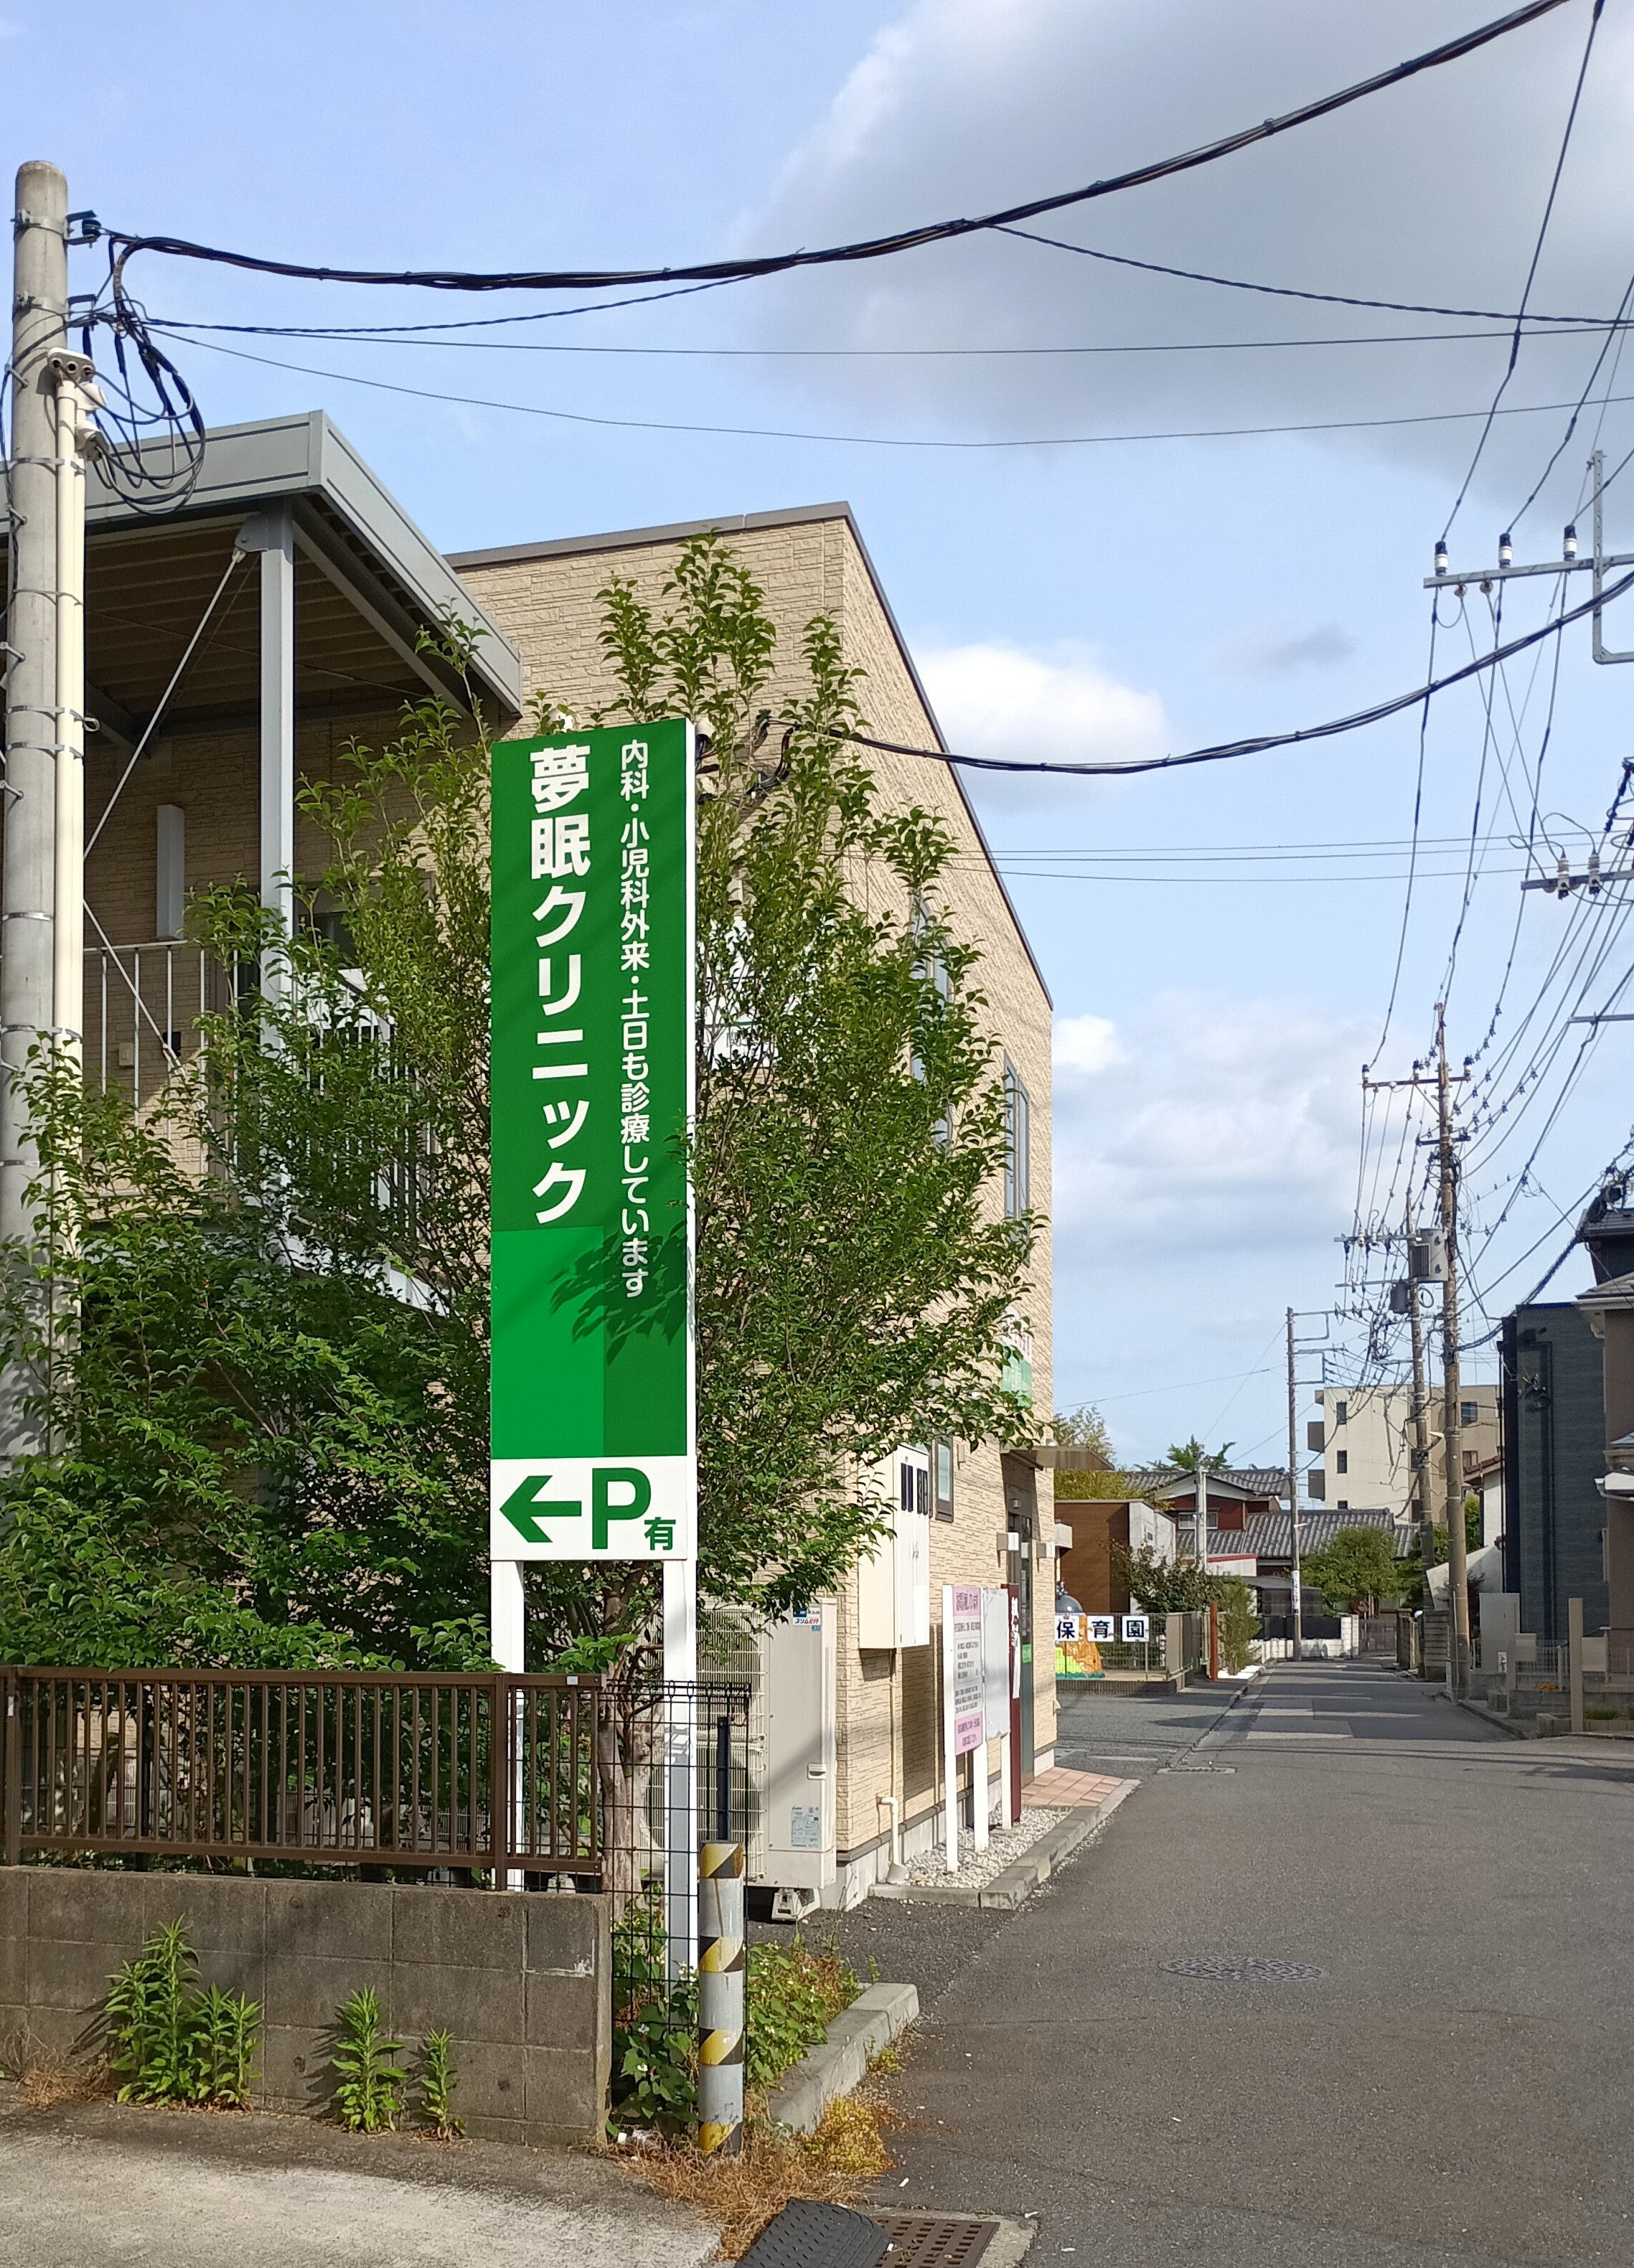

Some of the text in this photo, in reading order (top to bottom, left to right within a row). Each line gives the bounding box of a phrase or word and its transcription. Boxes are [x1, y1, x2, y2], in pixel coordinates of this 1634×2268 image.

[530, 744, 591, 1224] 夢眠クリニック
[621, 739, 650, 1298] 内科・小児科外来・土日も診療しています
[1056, 1619, 1145, 1639] 保育園
